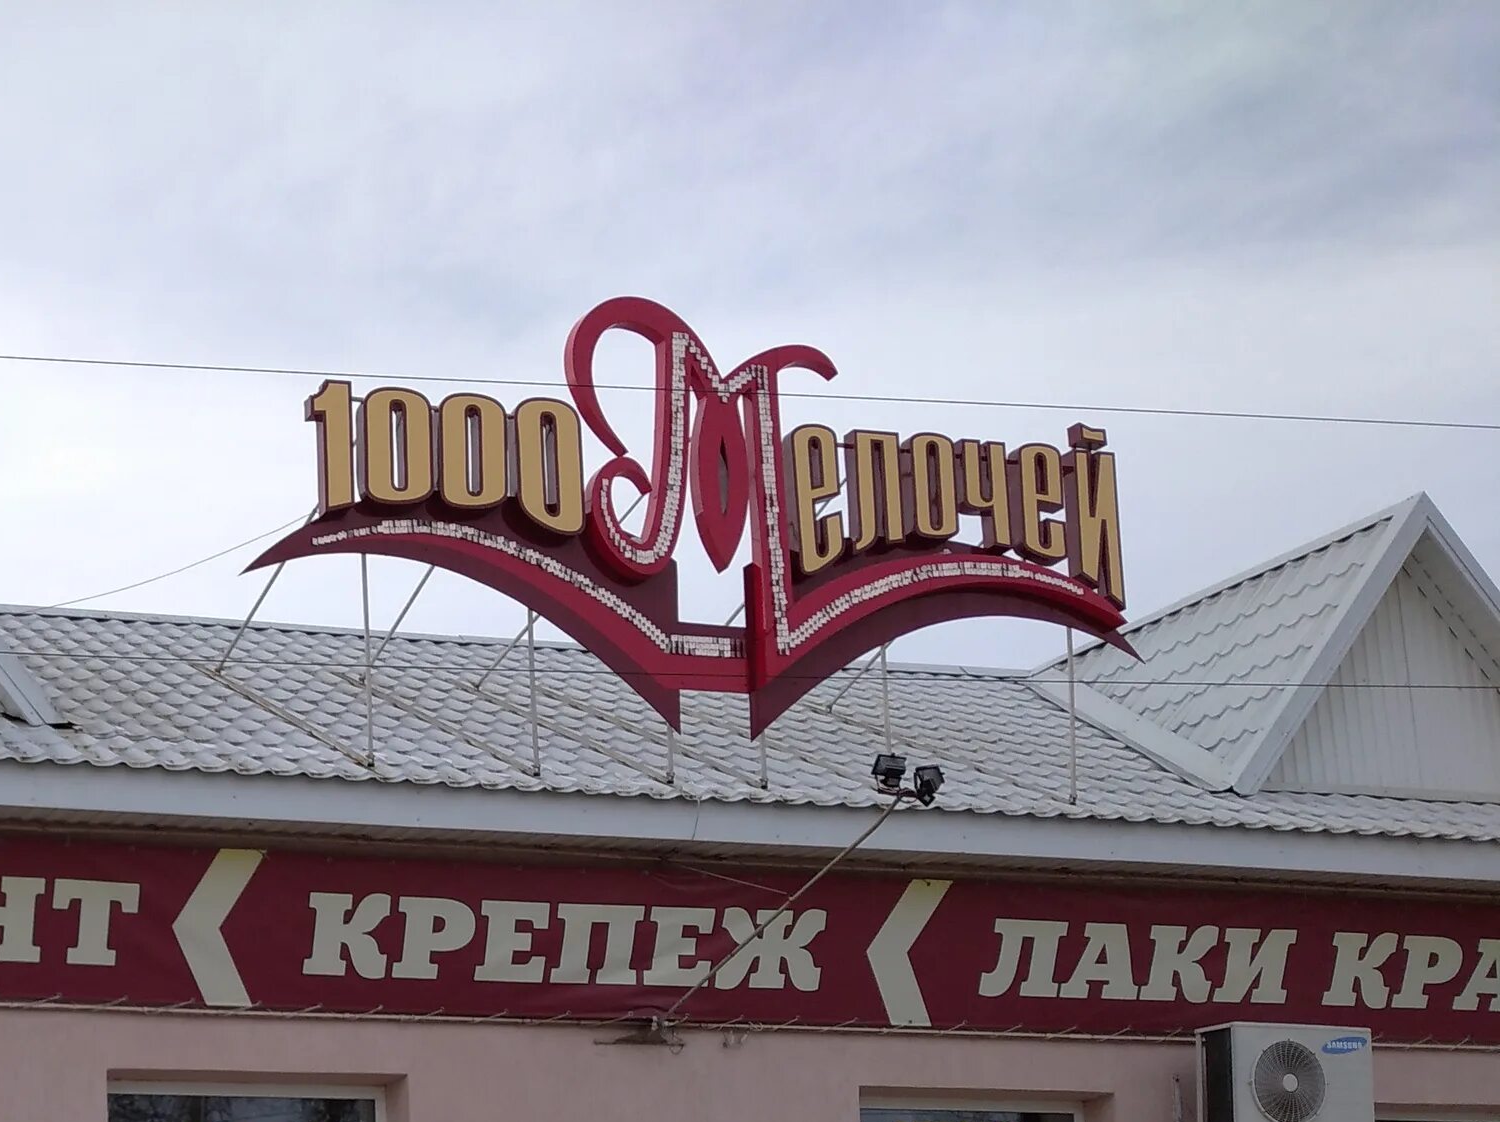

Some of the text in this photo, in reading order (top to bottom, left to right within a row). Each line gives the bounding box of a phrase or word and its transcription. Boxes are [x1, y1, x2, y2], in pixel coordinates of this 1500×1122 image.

[305, 378, 586, 537] 1000
[302, 891, 828, 991] КРЕПЕЖ
[978, 917, 1298, 1004] ЛАКИ
[1325, 1040, 1364, 1050] SAMSUNG
